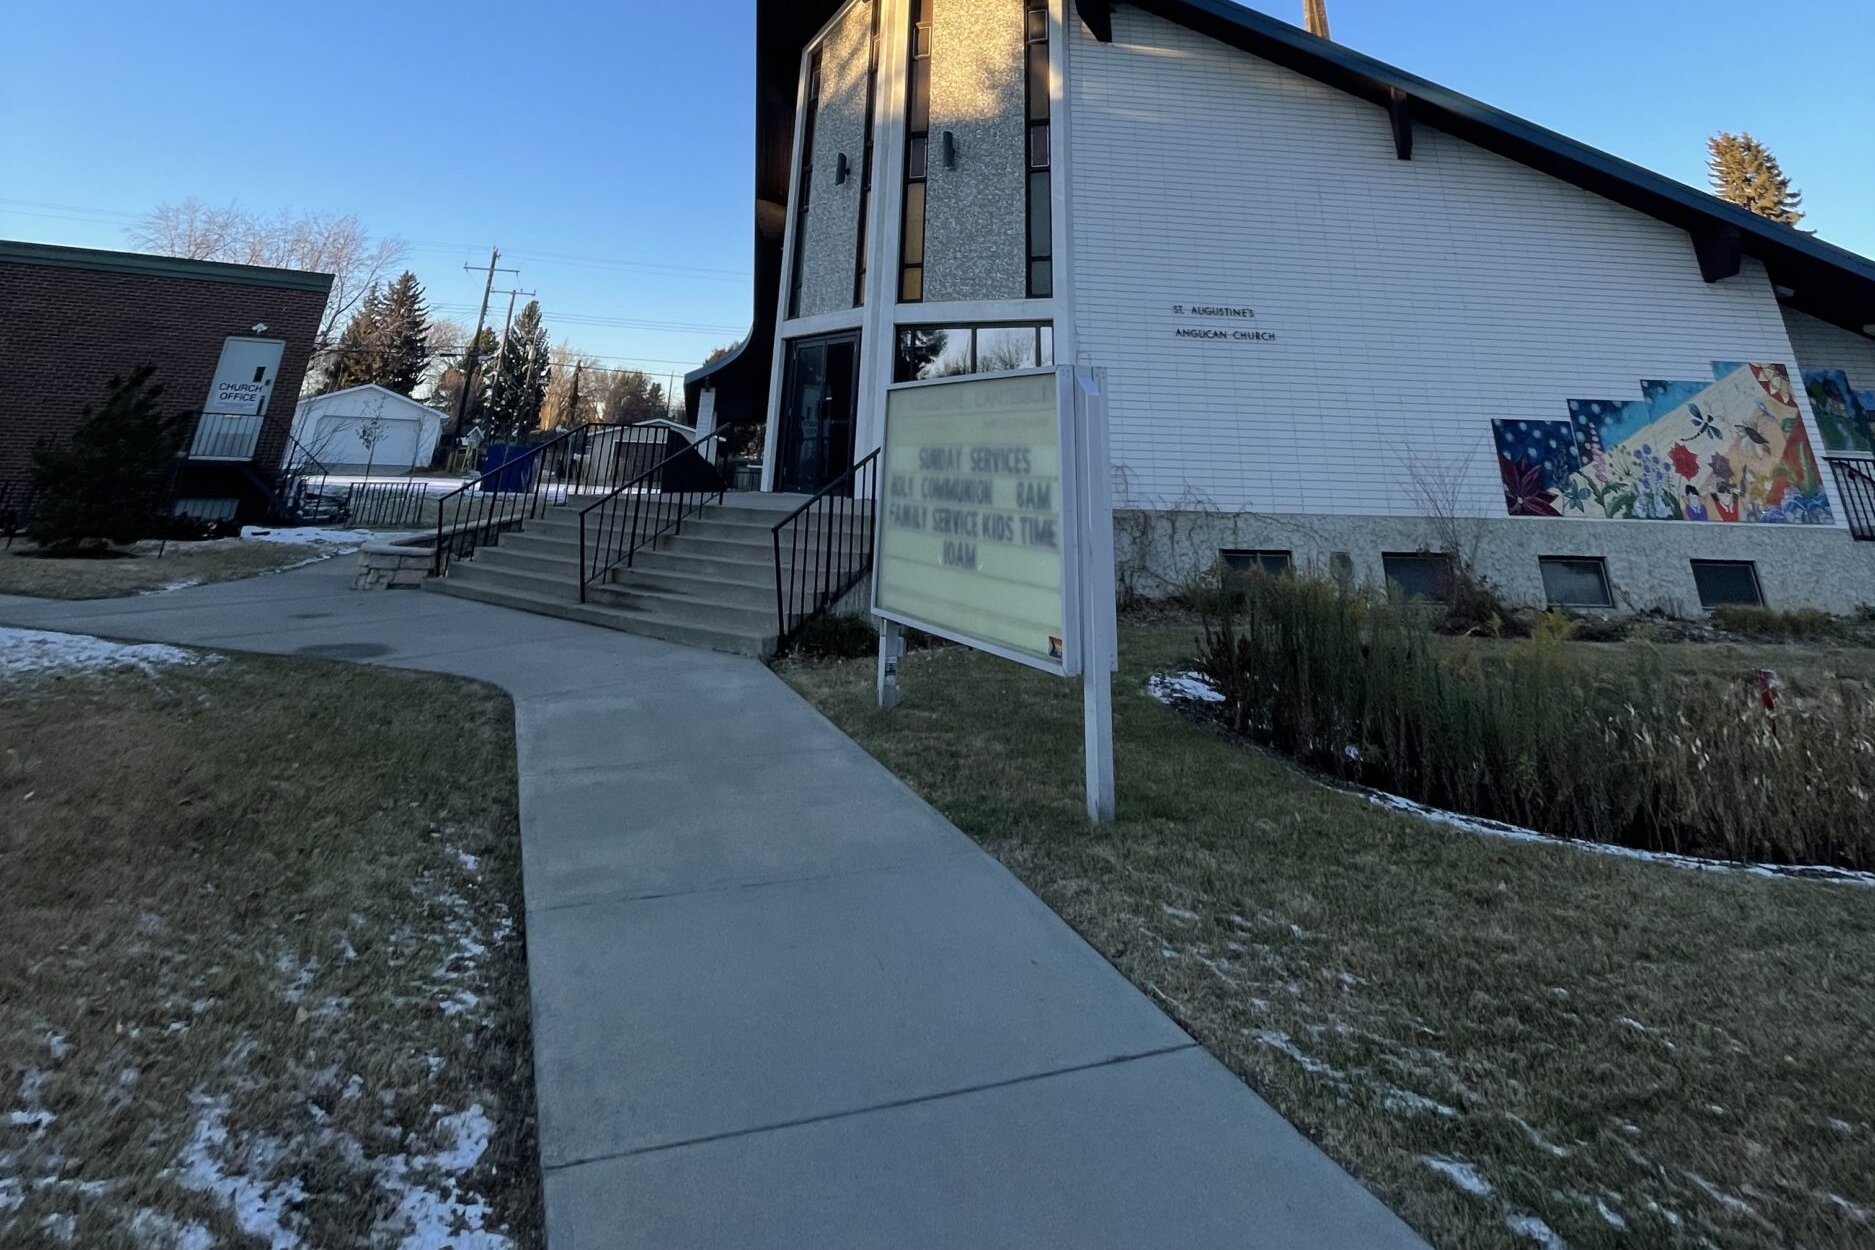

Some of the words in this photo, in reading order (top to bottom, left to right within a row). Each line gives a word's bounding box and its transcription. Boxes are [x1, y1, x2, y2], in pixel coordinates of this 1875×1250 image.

[1191, 306, 1254, 318] AUGUSTINE'S
[1175, 328, 1227, 339] ANGLICAN
[1232, 331, 1275, 341] CHURCH
[219, 382, 262, 392] CHURCH
[219, 392, 257, 401] OFFICE
[919, 447, 962, 471] SUNDAY
[970, 447, 1031, 474] SERVICES
[921, 476, 993, 506] COMMUNION
[1016, 481, 1052, 510] 8AM
[889, 503, 928, 530] FAMILY
[932, 507, 978, 537] SERVICE
[982, 512, 1014, 542] KIDS
[1020, 516, 1057, 548] TIME
[943, 540, 977, 569] 10AM
